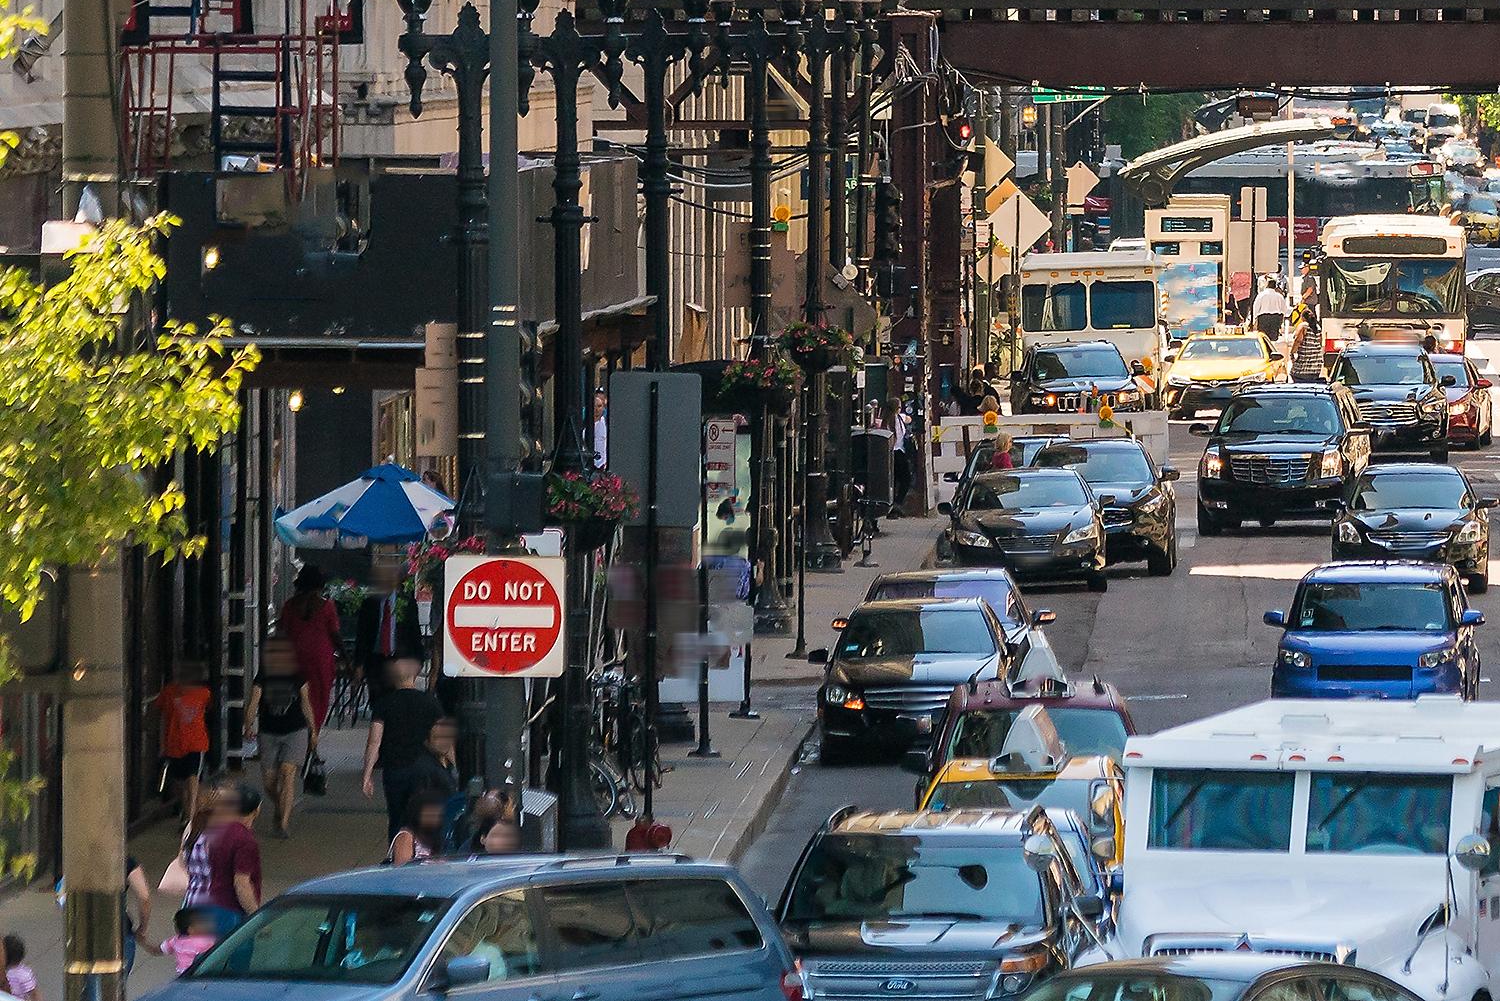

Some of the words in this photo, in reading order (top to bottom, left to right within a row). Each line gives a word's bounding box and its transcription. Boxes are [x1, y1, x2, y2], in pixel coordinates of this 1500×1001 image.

[464, 580, 491, 601] DO
[504, 580, 546, 601] NOT
[471, 632, 536, 652] ENTER
[887, 980, 909, 990] Ford
